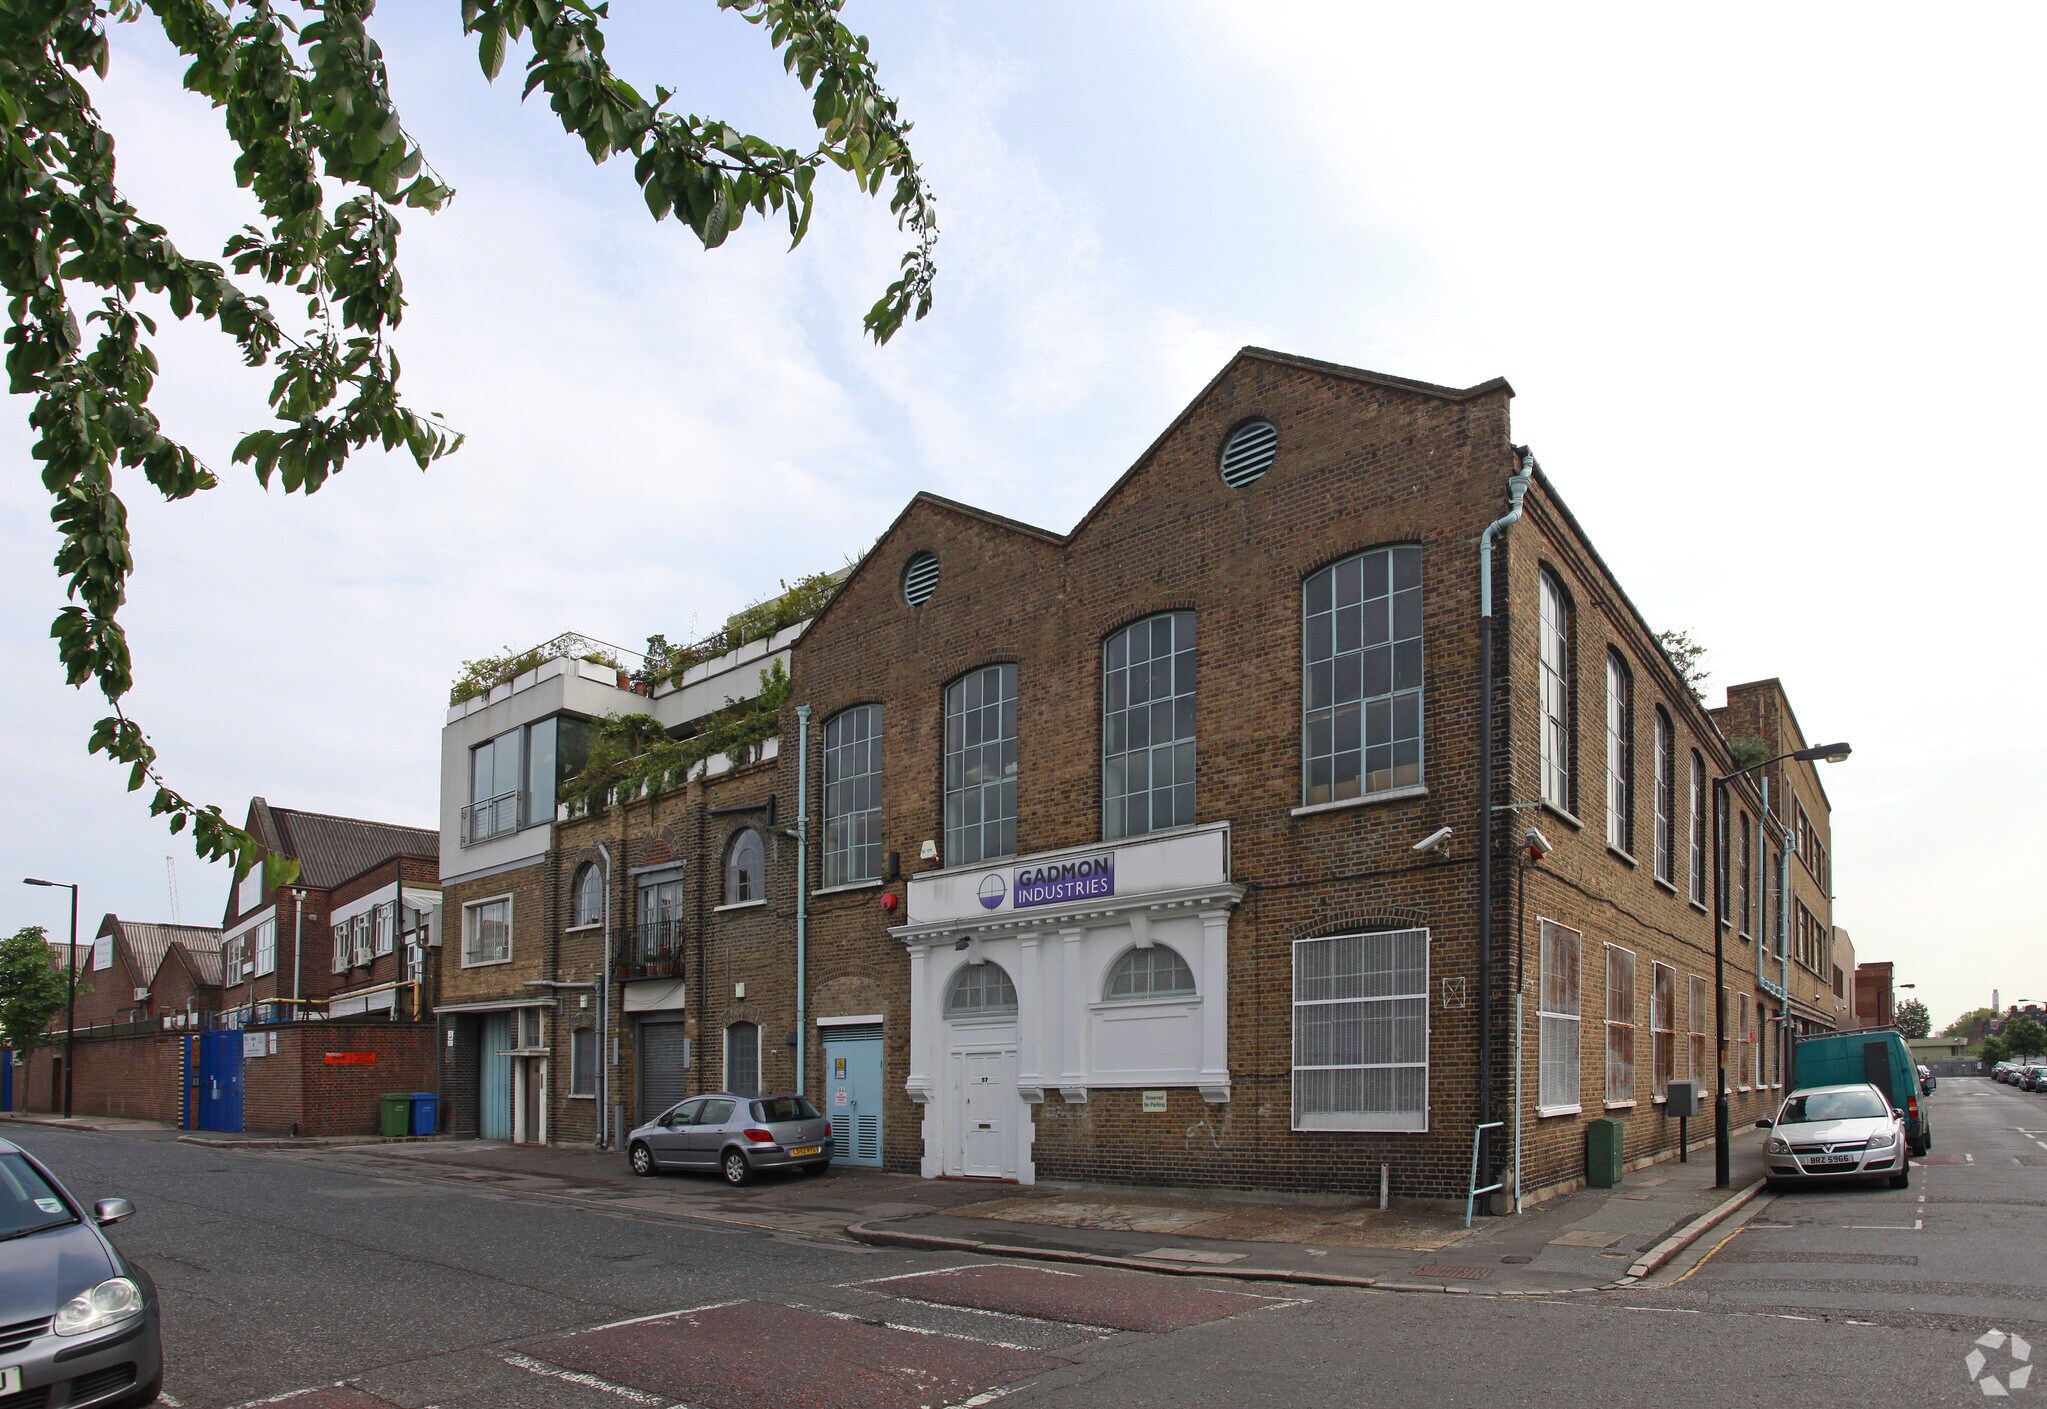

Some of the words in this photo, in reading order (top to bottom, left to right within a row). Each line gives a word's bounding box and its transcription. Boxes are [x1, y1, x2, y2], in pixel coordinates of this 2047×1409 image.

[1019, 857, 1109, 887] GADMON
[1018, 878, 1108, 903] INDUSTRIES
[1810, 1156, 1826, 1164] BRZ
[1828, 1155, 1849, 1163] 5966
